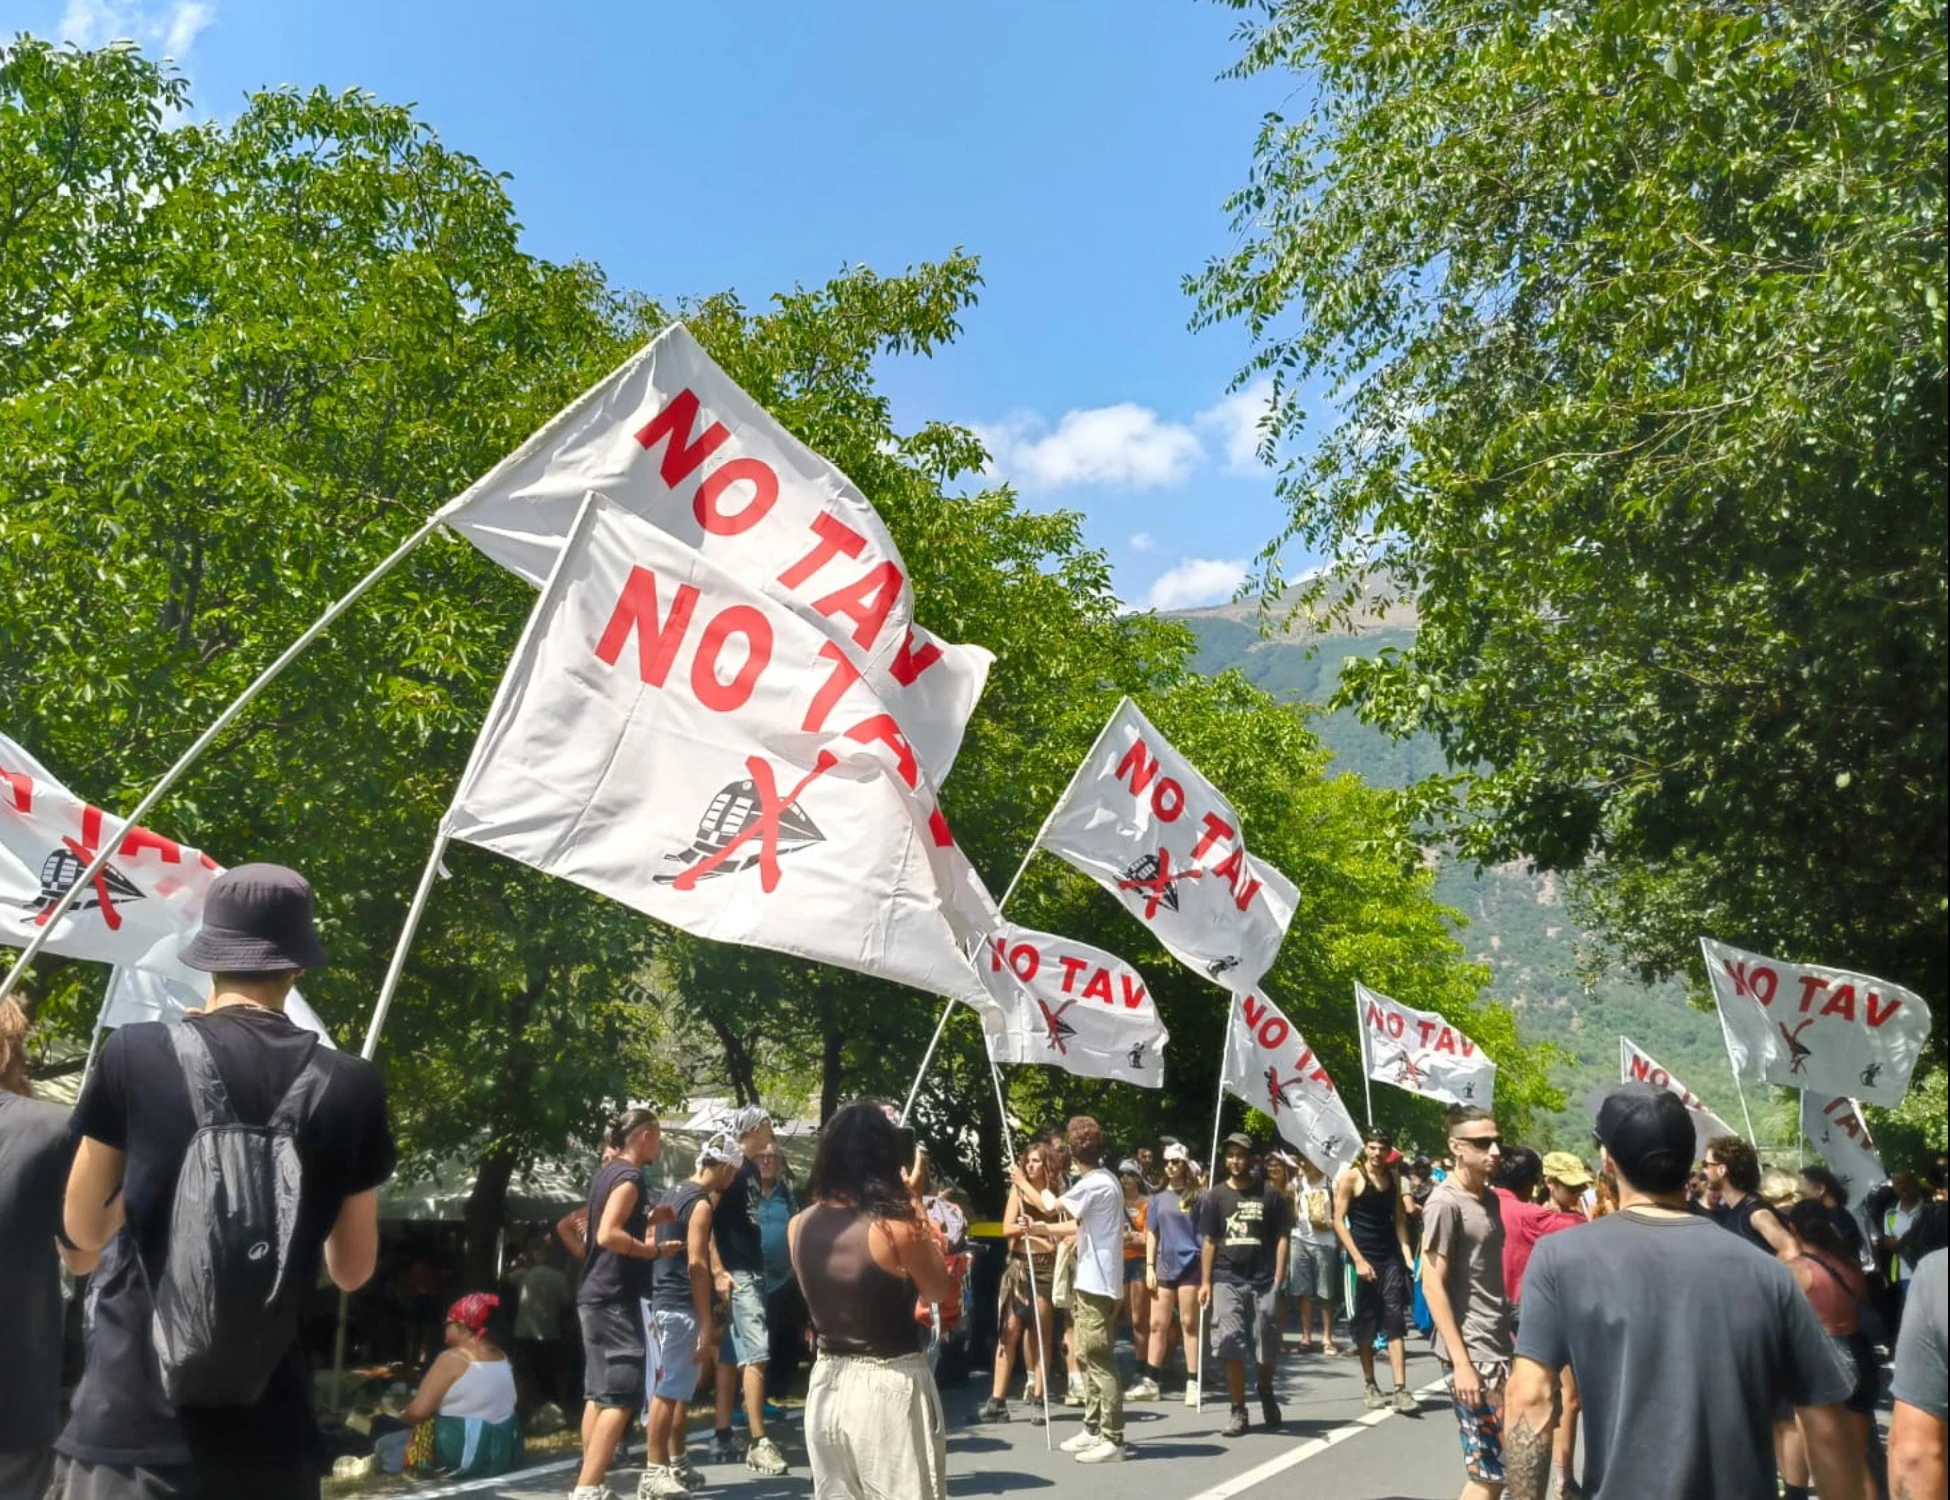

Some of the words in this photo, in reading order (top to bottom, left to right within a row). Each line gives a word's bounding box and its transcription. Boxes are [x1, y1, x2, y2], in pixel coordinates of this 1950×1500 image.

[634, 388, 779, 536] NO
[776, 510, 944, 687] TAV
[594, 564, 773, 713] NO
[801, 640, 954, 848] TA
[1115, 738, 1185, 823] NO
[1059, 955, 1146, 1009] TAV
[1799, 976, 1902, 1027] TAV
[1243, 994, 1290, 1050] NO
[1366, 1000, 1405, 1039] NO
[1417, 1020, 1475, 1057] TAV
[1630, 1054, 1670, 1089] NO
